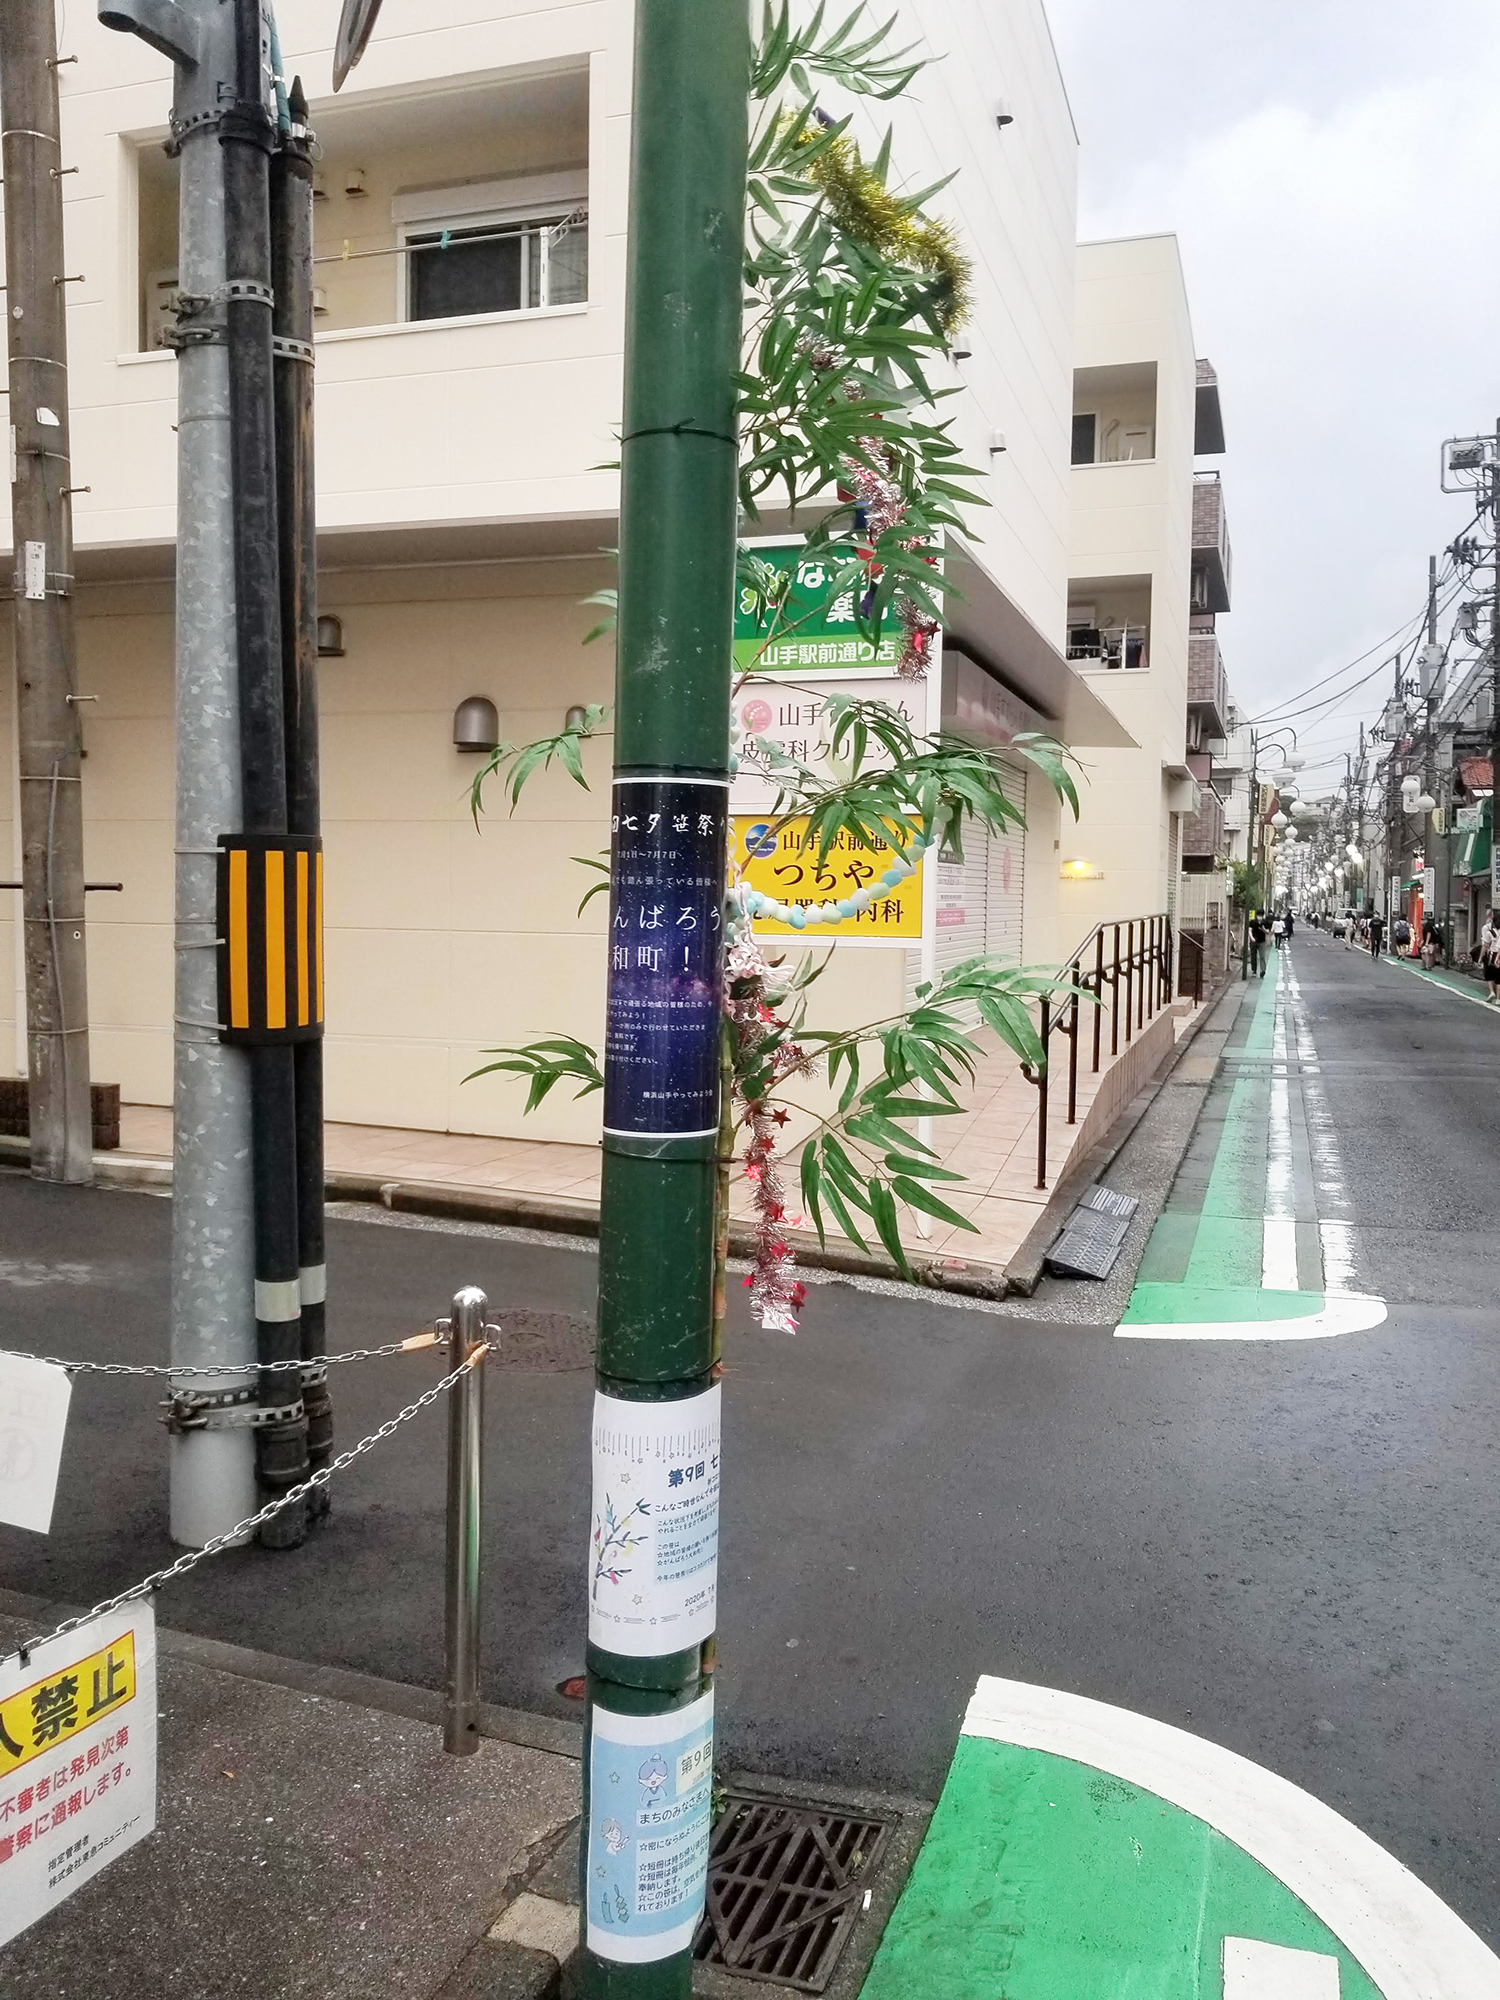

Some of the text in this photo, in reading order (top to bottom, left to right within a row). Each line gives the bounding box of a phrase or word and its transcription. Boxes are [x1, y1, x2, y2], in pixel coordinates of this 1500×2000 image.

[760, 640, 896, 666] 山手駅前通り店
[773, 858, 874, 891] つちや
[668, 1461, 705, 1488] 第9回
[0, 1725, 129, 1823] 不審者は発見次第
[681, 1740, 712, 1776] 第9回
[639, 1788, 709, 1825] まちのみなさまへ
